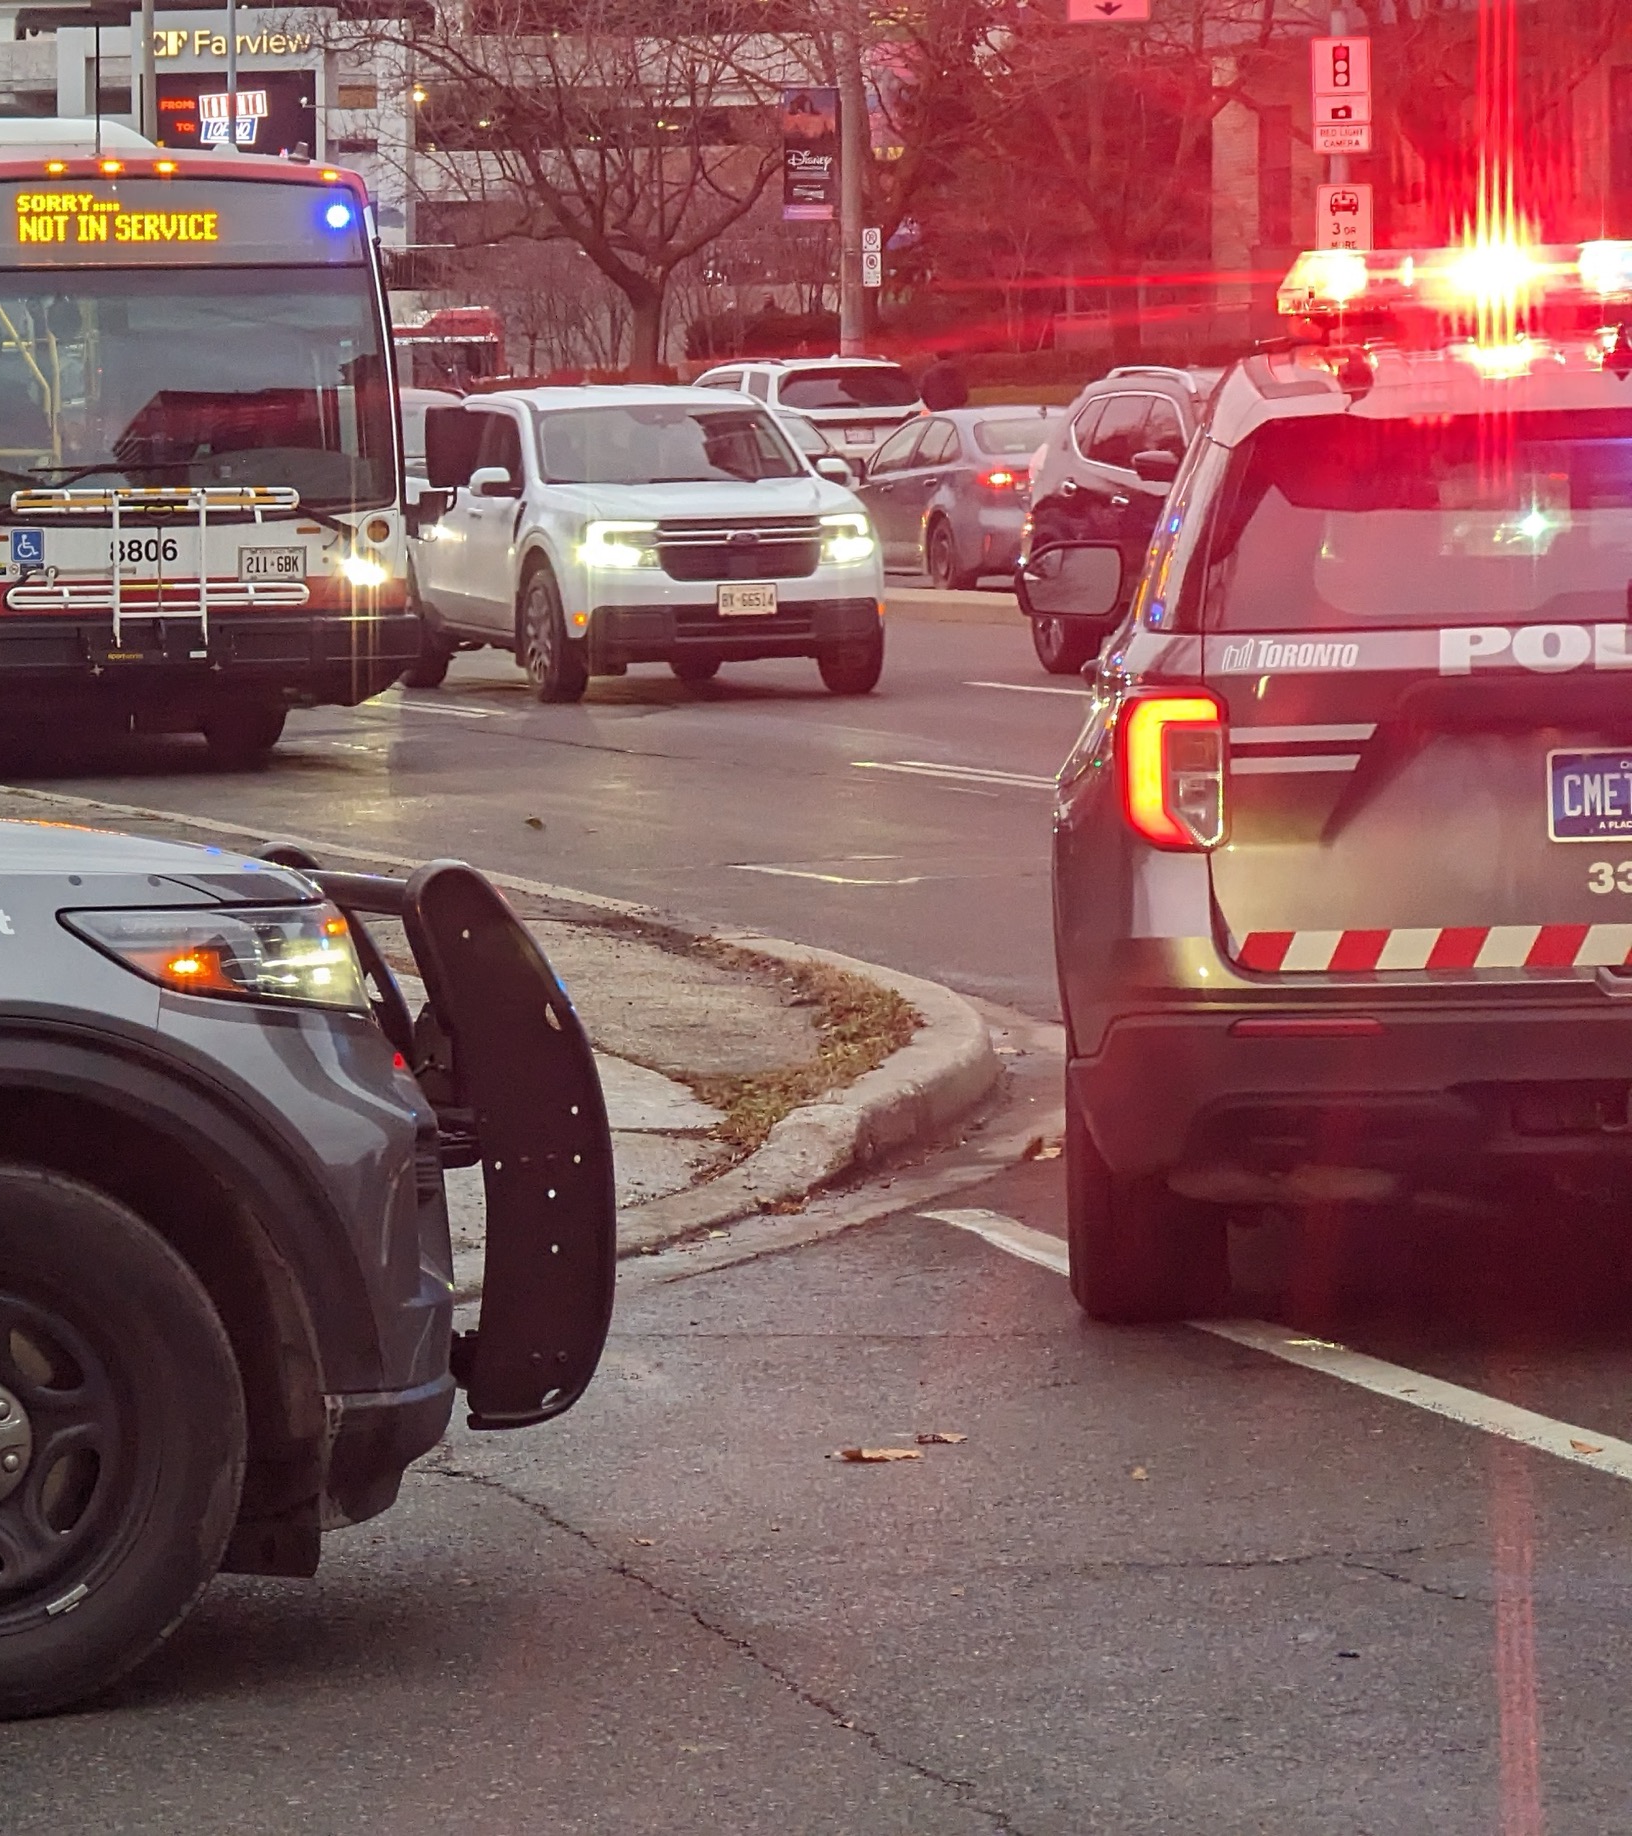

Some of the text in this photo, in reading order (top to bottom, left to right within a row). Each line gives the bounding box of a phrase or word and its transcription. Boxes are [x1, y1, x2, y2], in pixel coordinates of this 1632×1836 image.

[194, 29, 312, 55] Farview
[202, 93, 264, 118] TORNTO
[786, 149, 833, 172] Disney
[19, 213, 219, 242] NOT IN SERVICE
[1331, 222, 1357, 235] 3 OR
[109, 538, 179, 562] 8806
[1256, 639, 1360, 669] TORONTO
